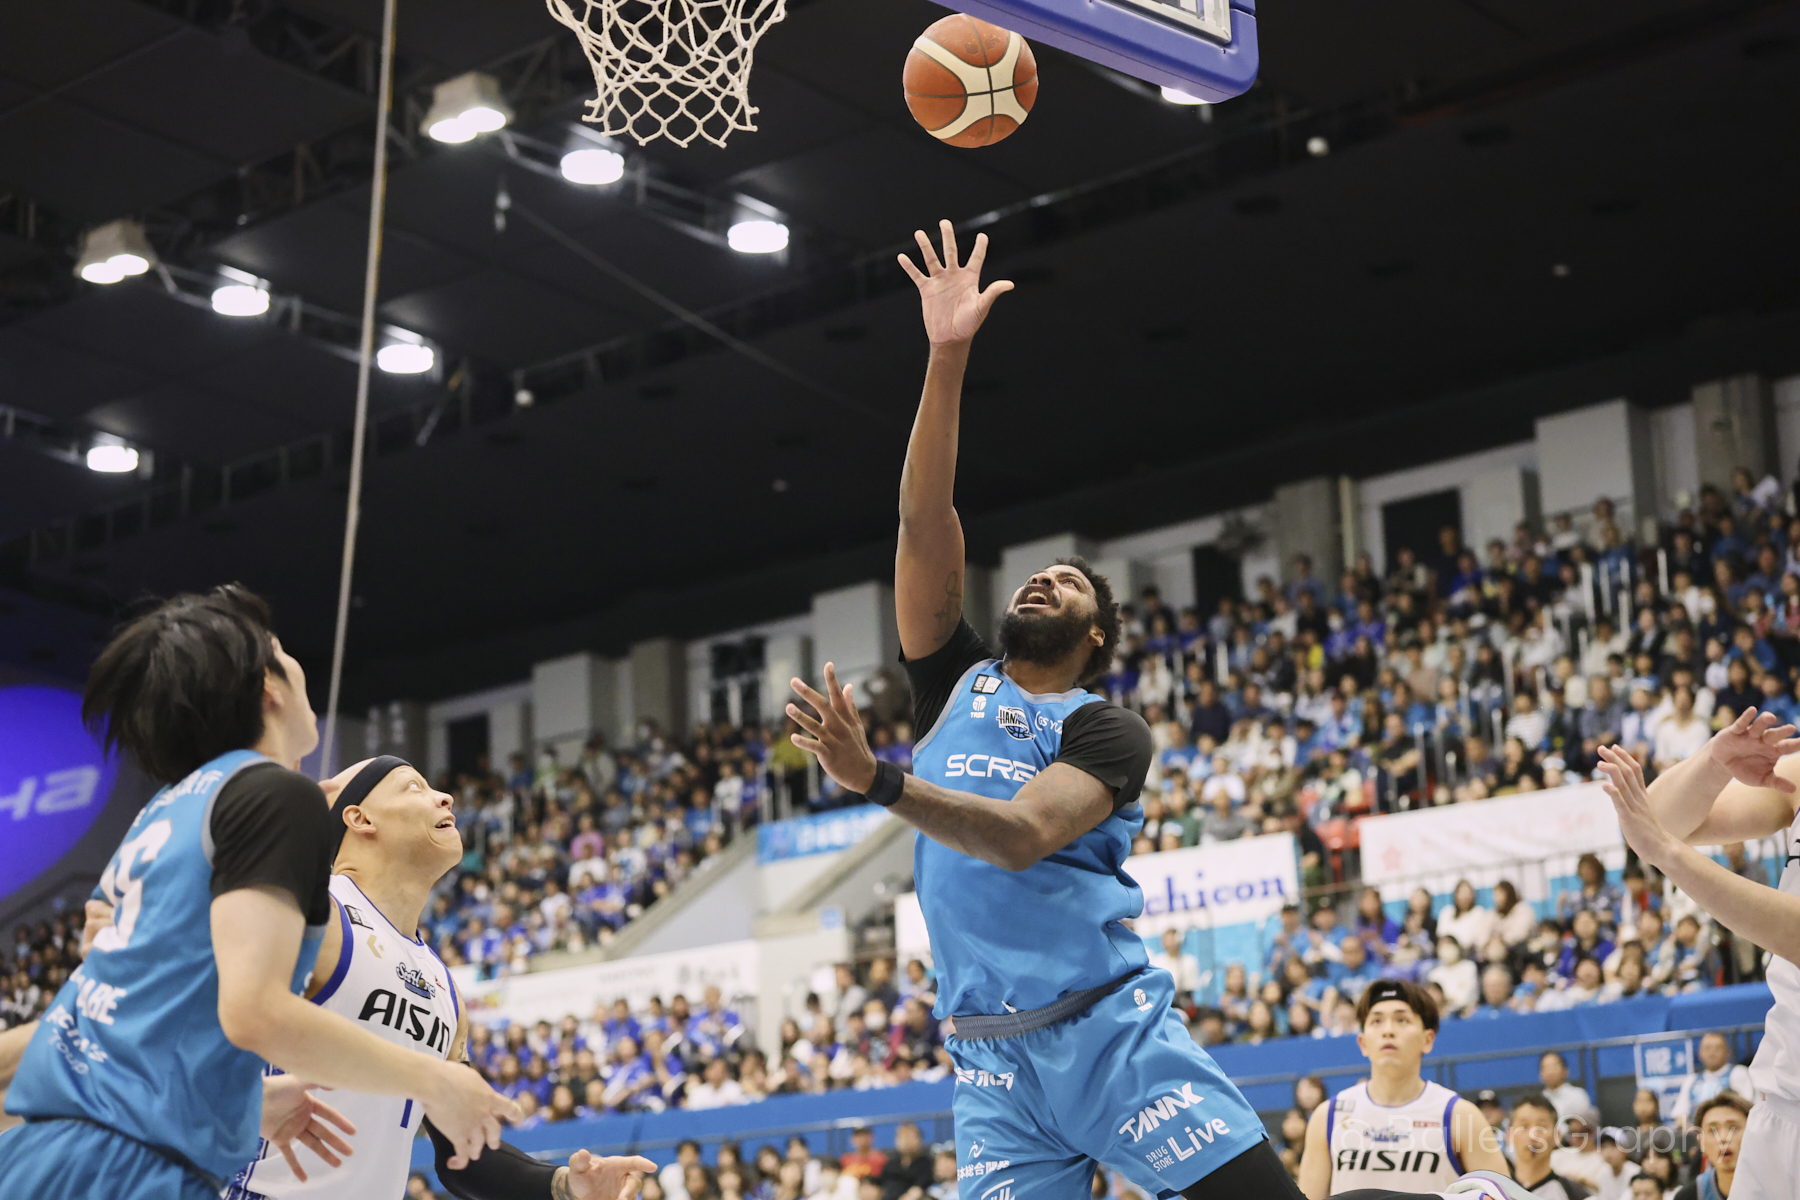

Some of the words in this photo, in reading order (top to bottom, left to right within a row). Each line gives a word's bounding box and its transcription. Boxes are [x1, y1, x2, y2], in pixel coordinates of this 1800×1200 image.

[945, 753, 1040, 783] SCRE
[1145, 872, 1284, 916] chicon
[358, 988, 450, 1057] AISIN
[1145, 1145, 1169, 1163] DRUG
[1166, 1118, 1231, 1161] Live
[1153, 1154, 1175, 1172] STORE
[1337, 1148, 1441, 1174] AISIN
